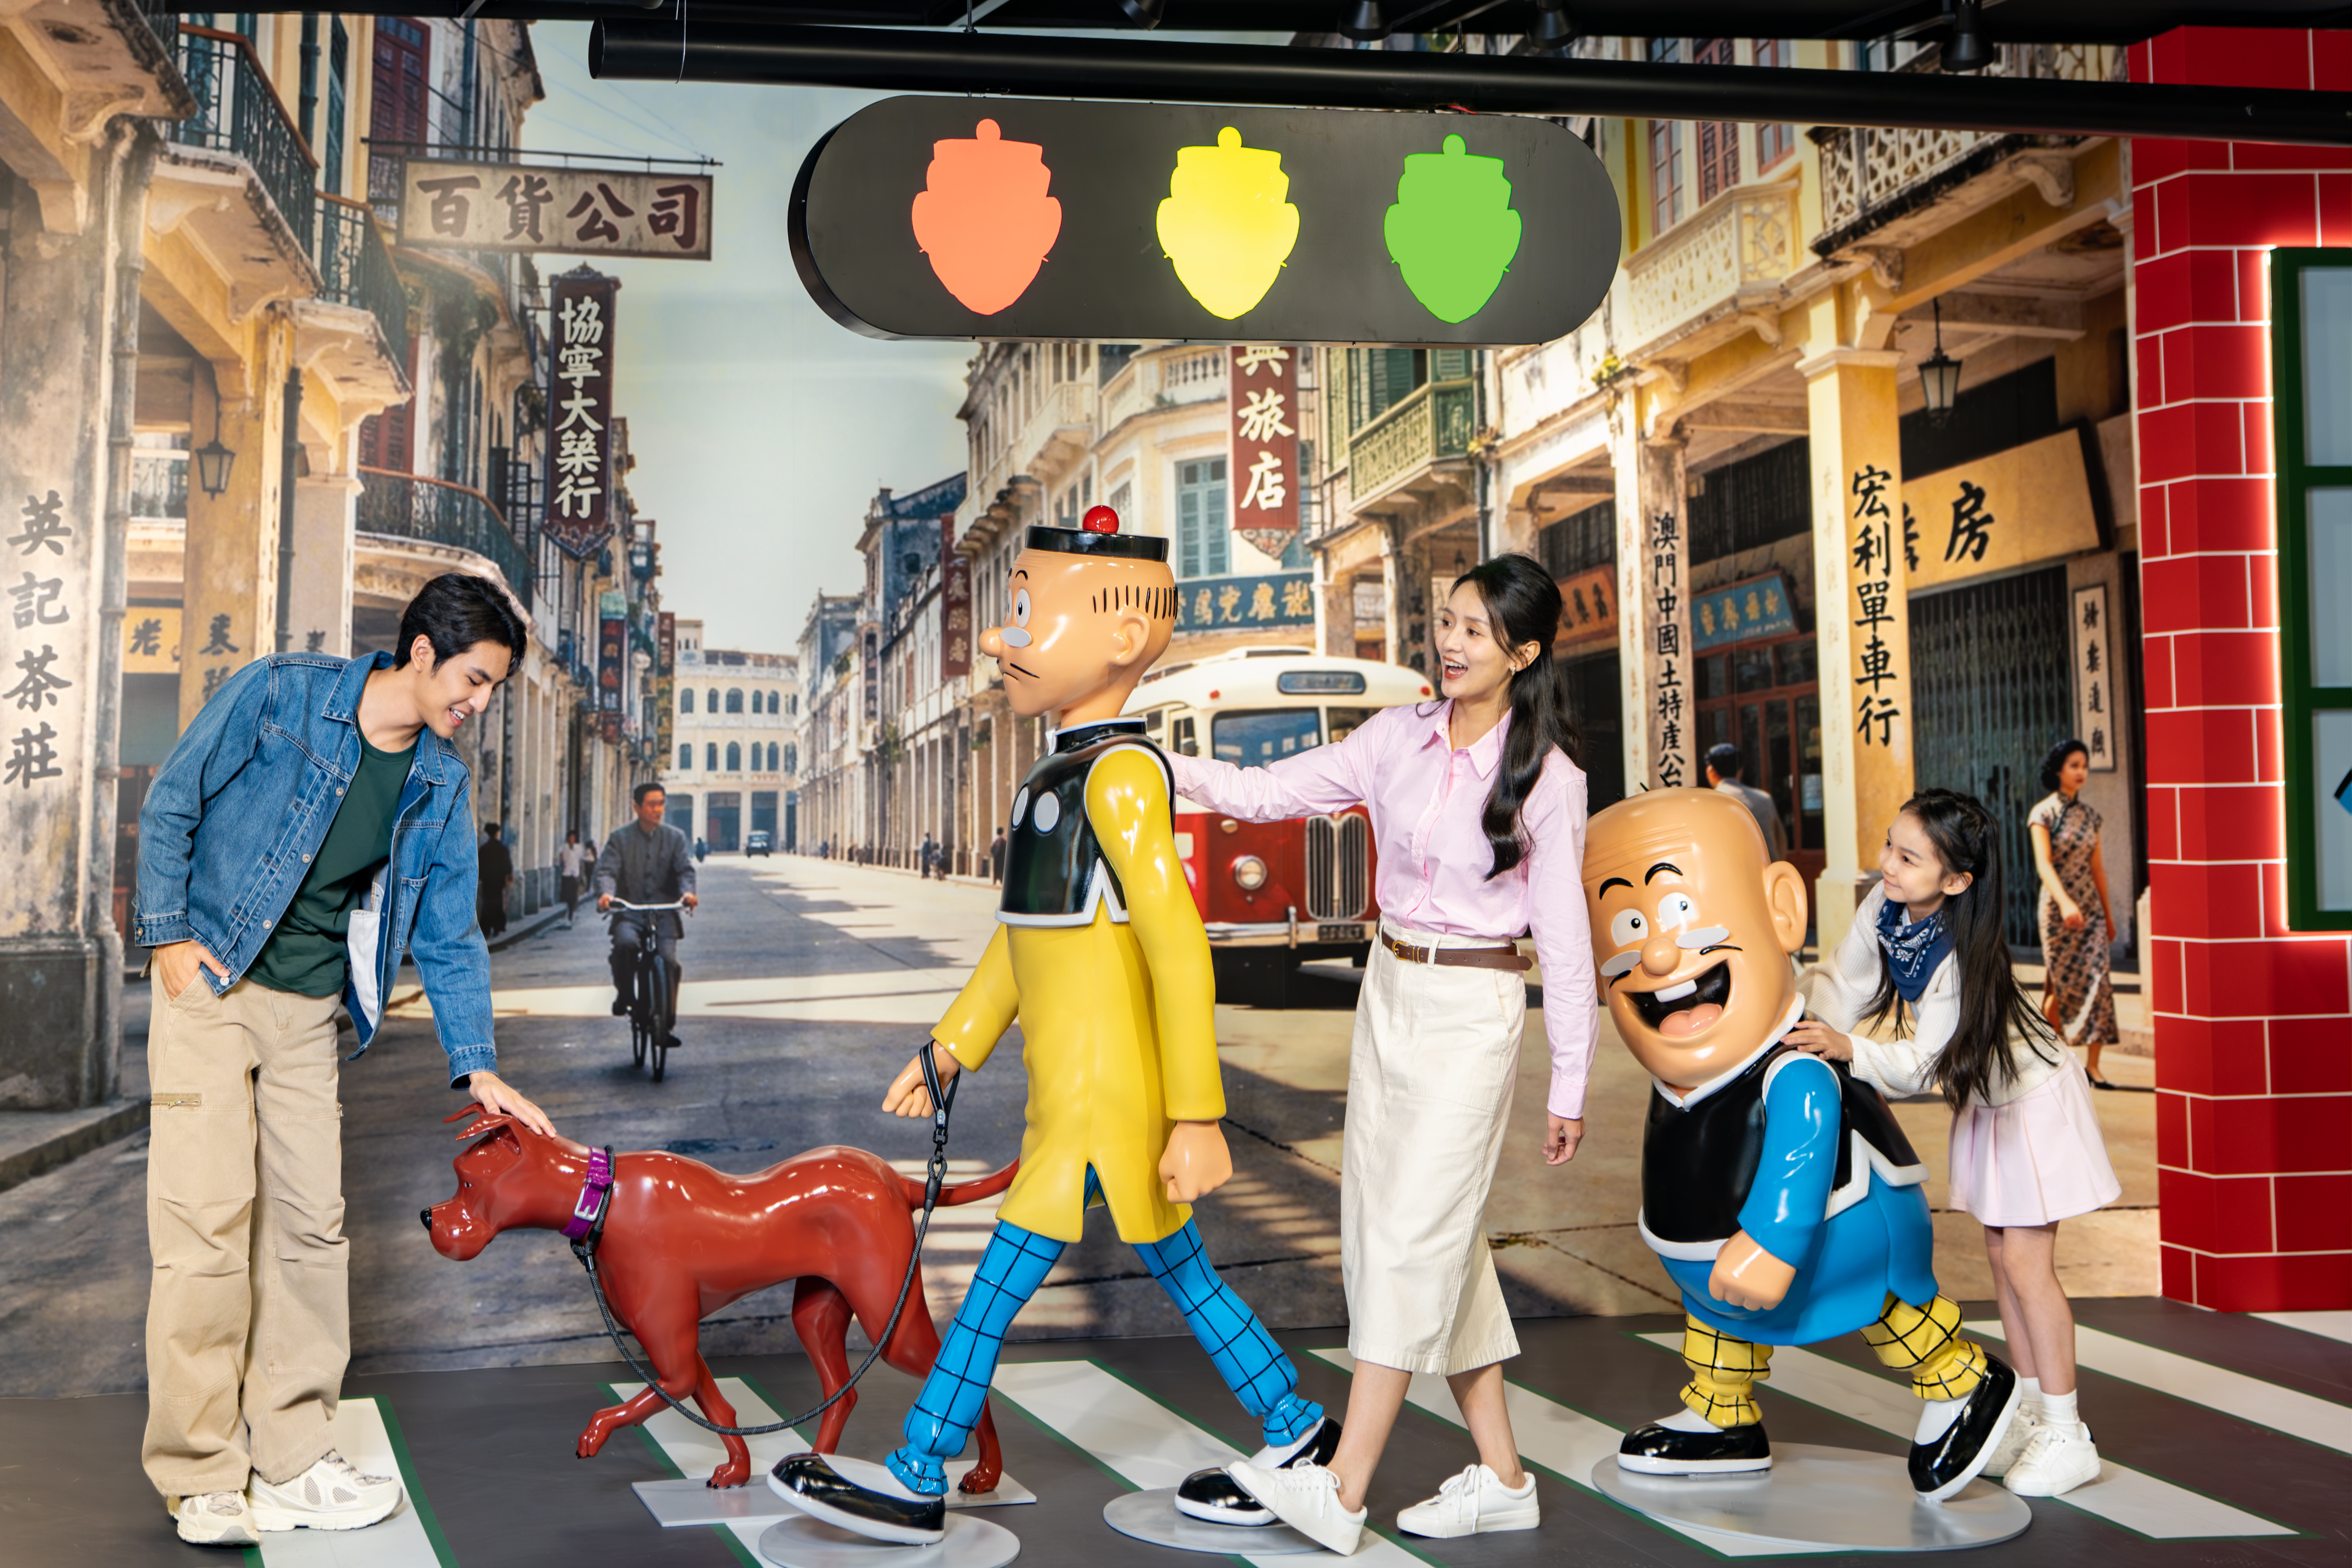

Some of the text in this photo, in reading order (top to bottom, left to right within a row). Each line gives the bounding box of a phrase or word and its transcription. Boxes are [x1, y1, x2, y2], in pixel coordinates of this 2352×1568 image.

[417, 175, 699, 249] 百貨公司
[3, 490, 72, 789] 英記茶莊
[1653, 512, 1685, 787] 澳門中國土特產公
[1852, 465, 1900, 747] 宏利單車行
